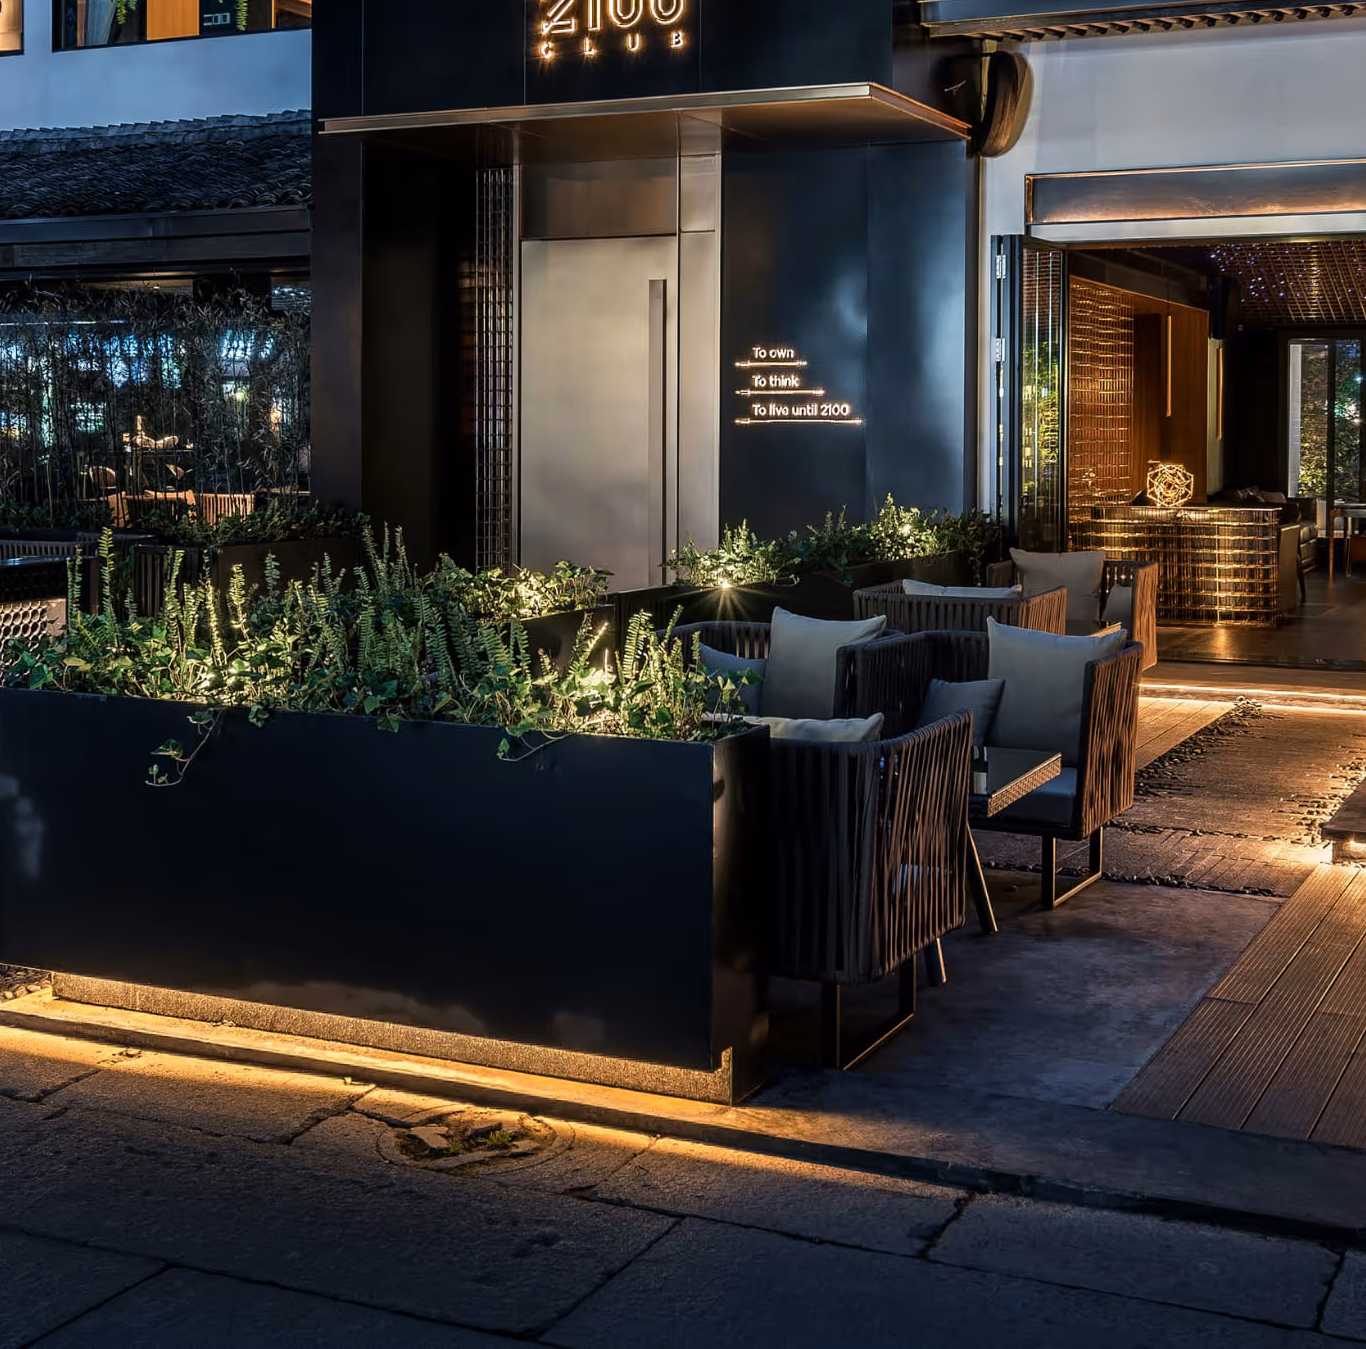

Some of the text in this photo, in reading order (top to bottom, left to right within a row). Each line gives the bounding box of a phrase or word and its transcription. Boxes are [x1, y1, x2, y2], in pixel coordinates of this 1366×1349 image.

[540, 30, 685, 59] CLUB
[752, 347, 794, 358] To own
[752, 375, 799, 387] To think
[752, 403, 849, 416] To live until 2100
